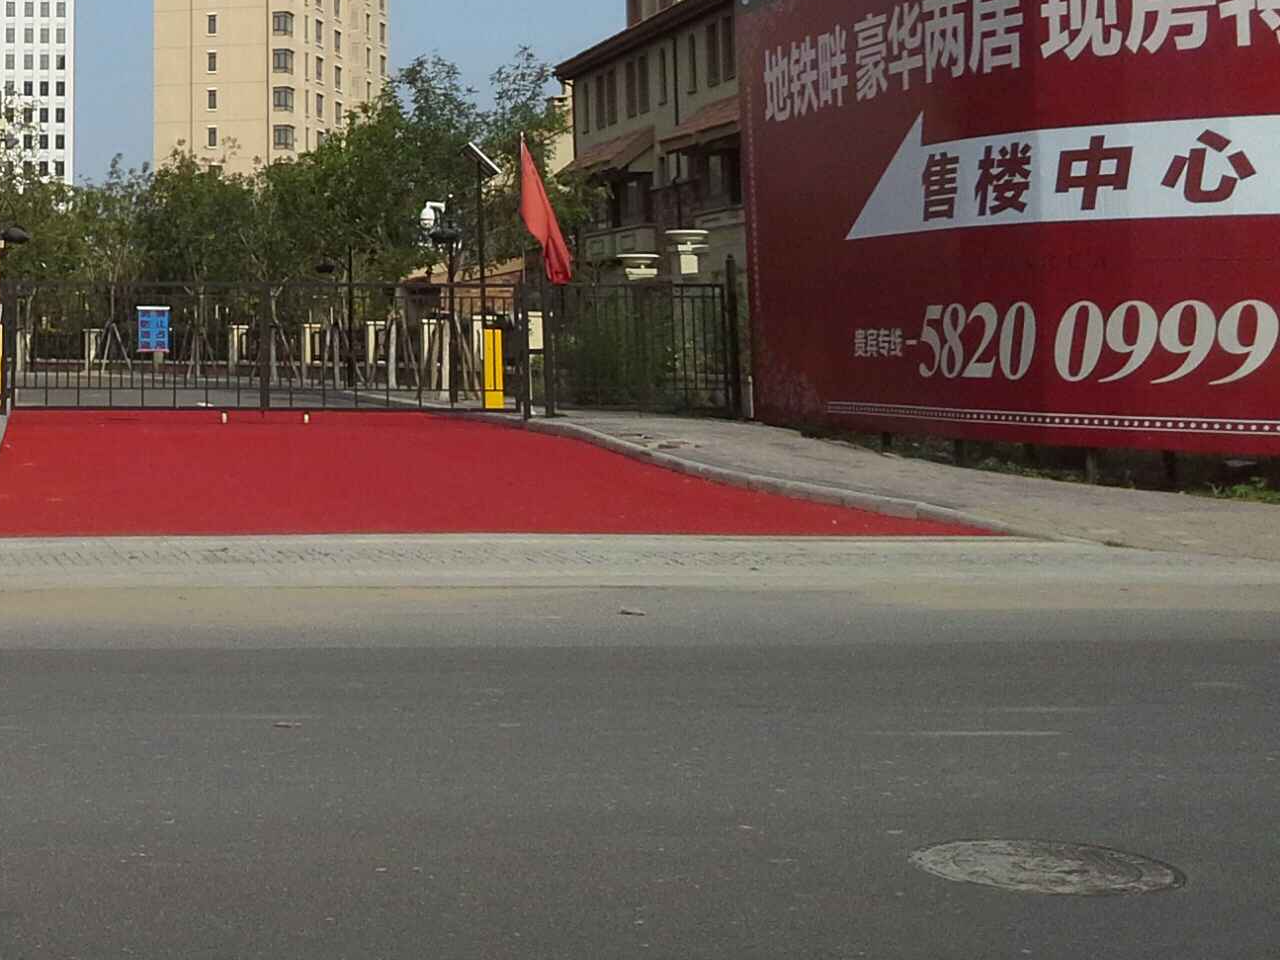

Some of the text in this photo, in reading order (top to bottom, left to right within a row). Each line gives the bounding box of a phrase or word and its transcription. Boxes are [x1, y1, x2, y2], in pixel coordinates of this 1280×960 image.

[763, 24, 849, 122] 地铁畔
[920, 129, 1257, 222] 售楼中心
[920, 302, 1036, 380] 5820
[1054, 299, 1280, 385] 0999
